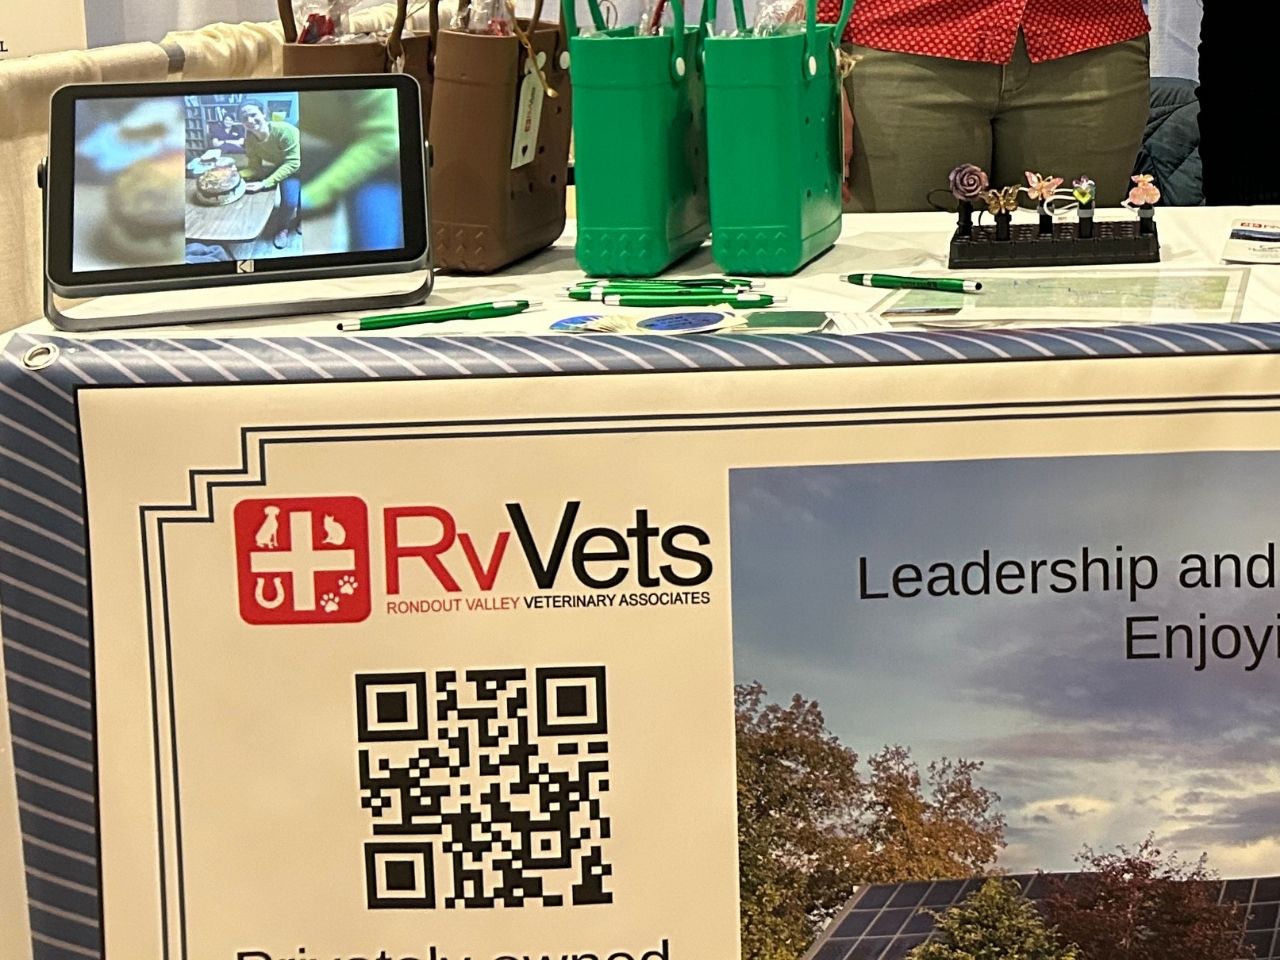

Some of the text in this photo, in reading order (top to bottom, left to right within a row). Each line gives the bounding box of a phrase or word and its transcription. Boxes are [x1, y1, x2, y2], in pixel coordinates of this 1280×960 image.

[383, 500, 714, 596] RvVets
[857, 543, 1159, 600] Leadership
[1178, 540, 1276, 589] and
[386, 591, 711, 615] RONDOUT VALLEY VETERINARY ASSOCIATES
